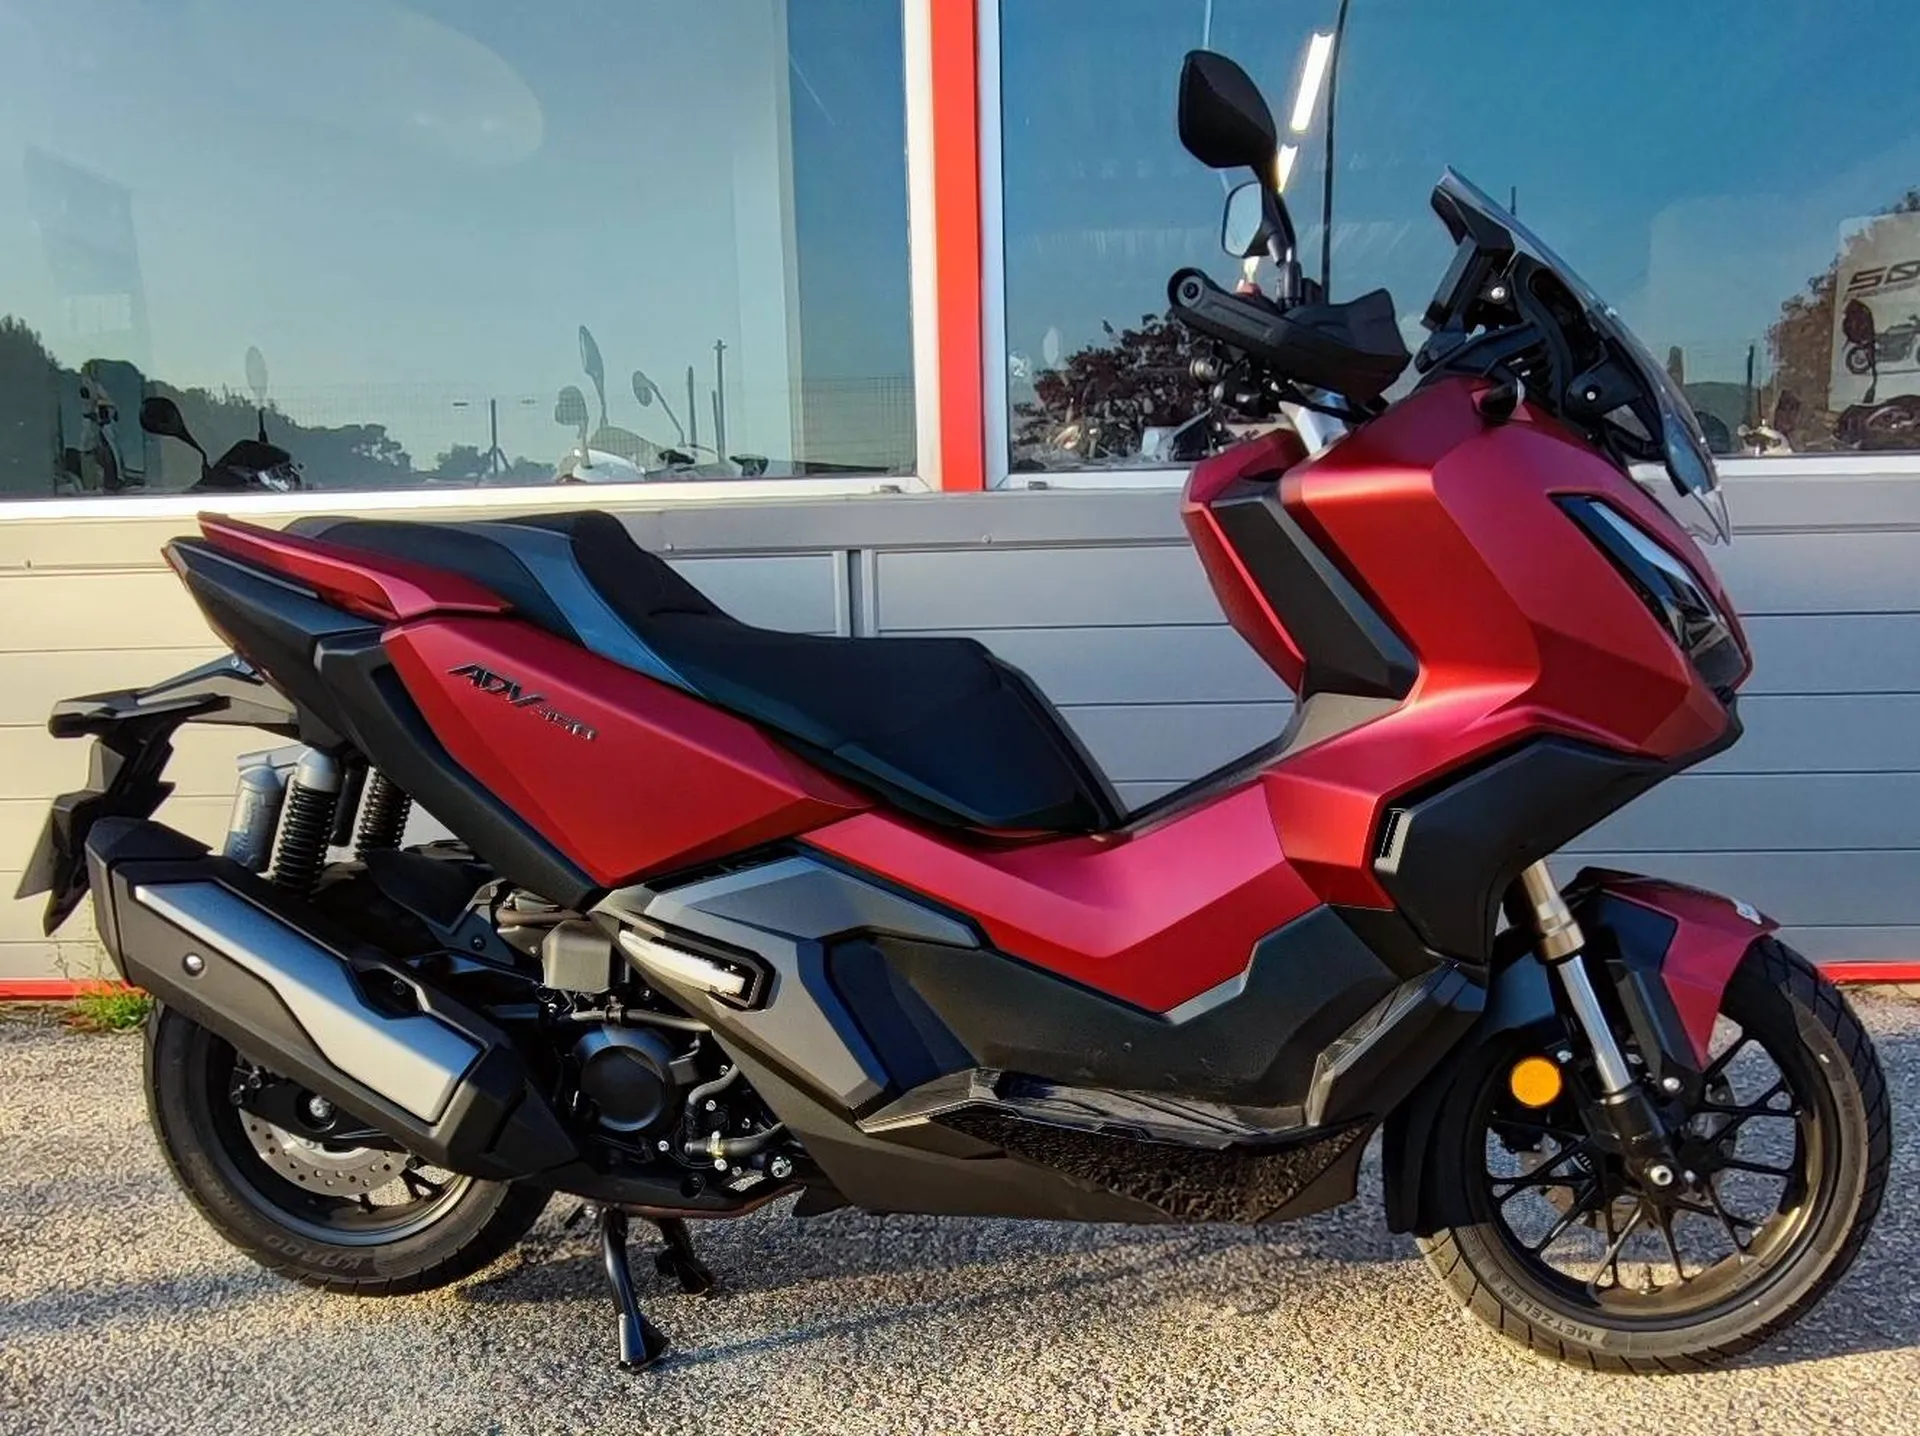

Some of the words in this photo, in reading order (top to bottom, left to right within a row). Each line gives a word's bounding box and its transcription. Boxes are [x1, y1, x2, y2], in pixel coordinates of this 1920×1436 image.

[446, 663, 546, 708] ADV
[264, 1234, 366, 1272] KAROO
[1500, 1284, 1596, 1342] METZELER
